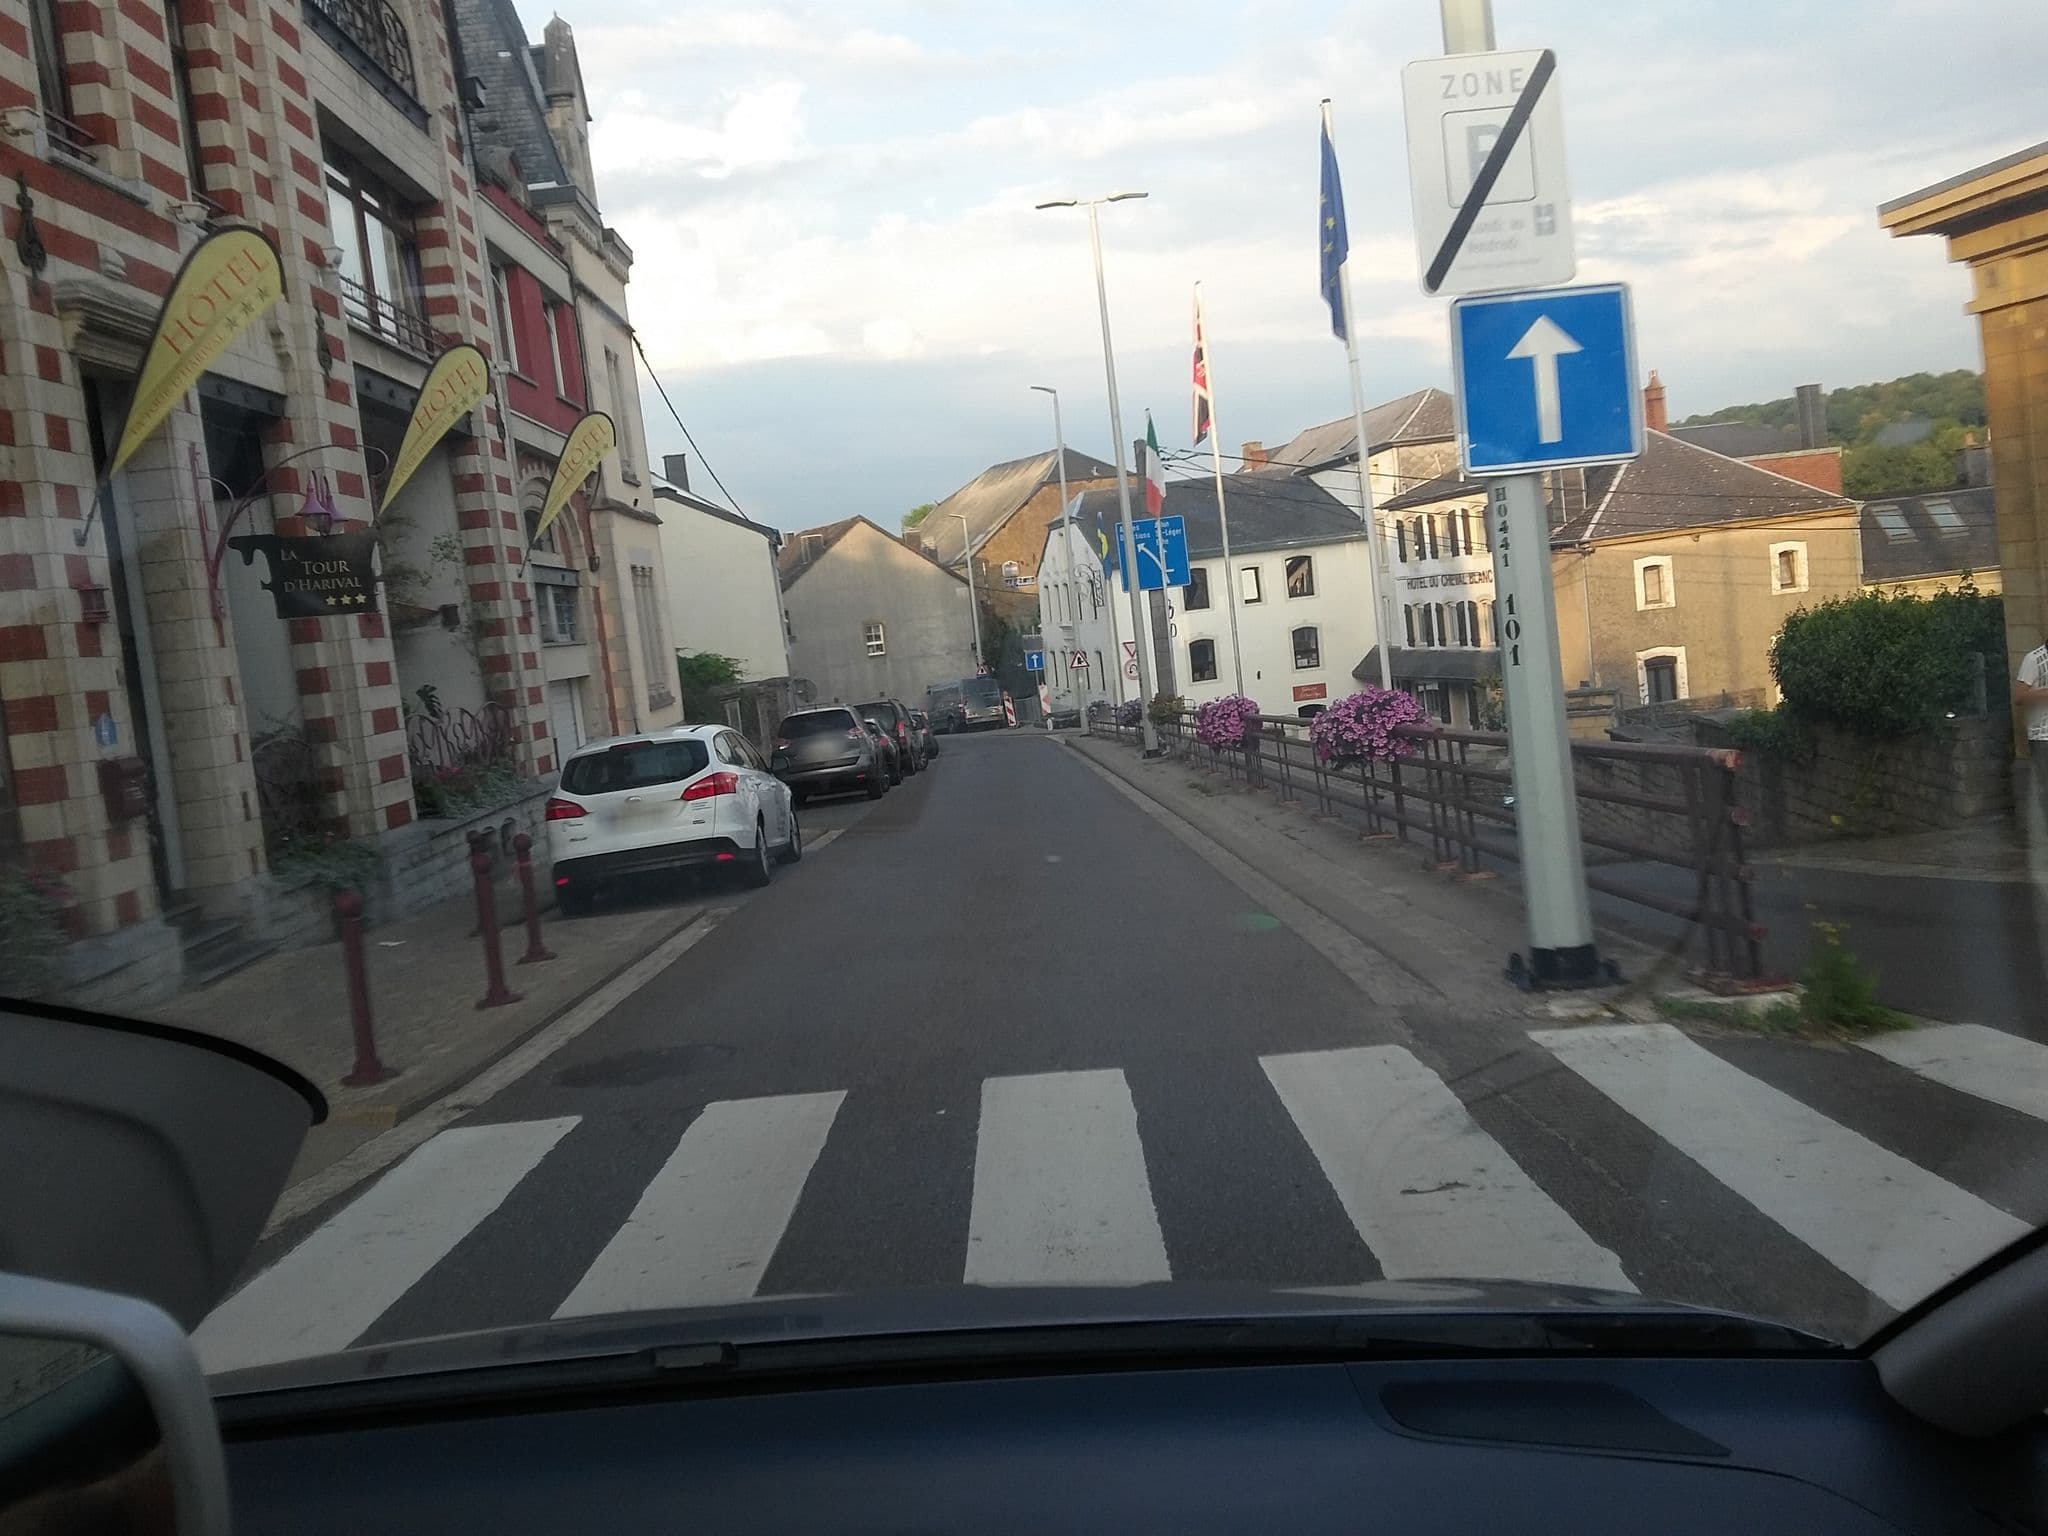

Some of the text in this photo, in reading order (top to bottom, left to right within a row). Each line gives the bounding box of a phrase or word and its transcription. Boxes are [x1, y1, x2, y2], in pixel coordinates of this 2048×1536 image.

[1440, 68, 1525, 99] ZONE
[280, 549, 297, 561] LA
[300, 560, 351, 575] TOUR
[283, 577, 361, 593] D'HARIVAL
[1469, 569, 1493, 585] BLANC
[1505, 593, 1521, 667] 101
